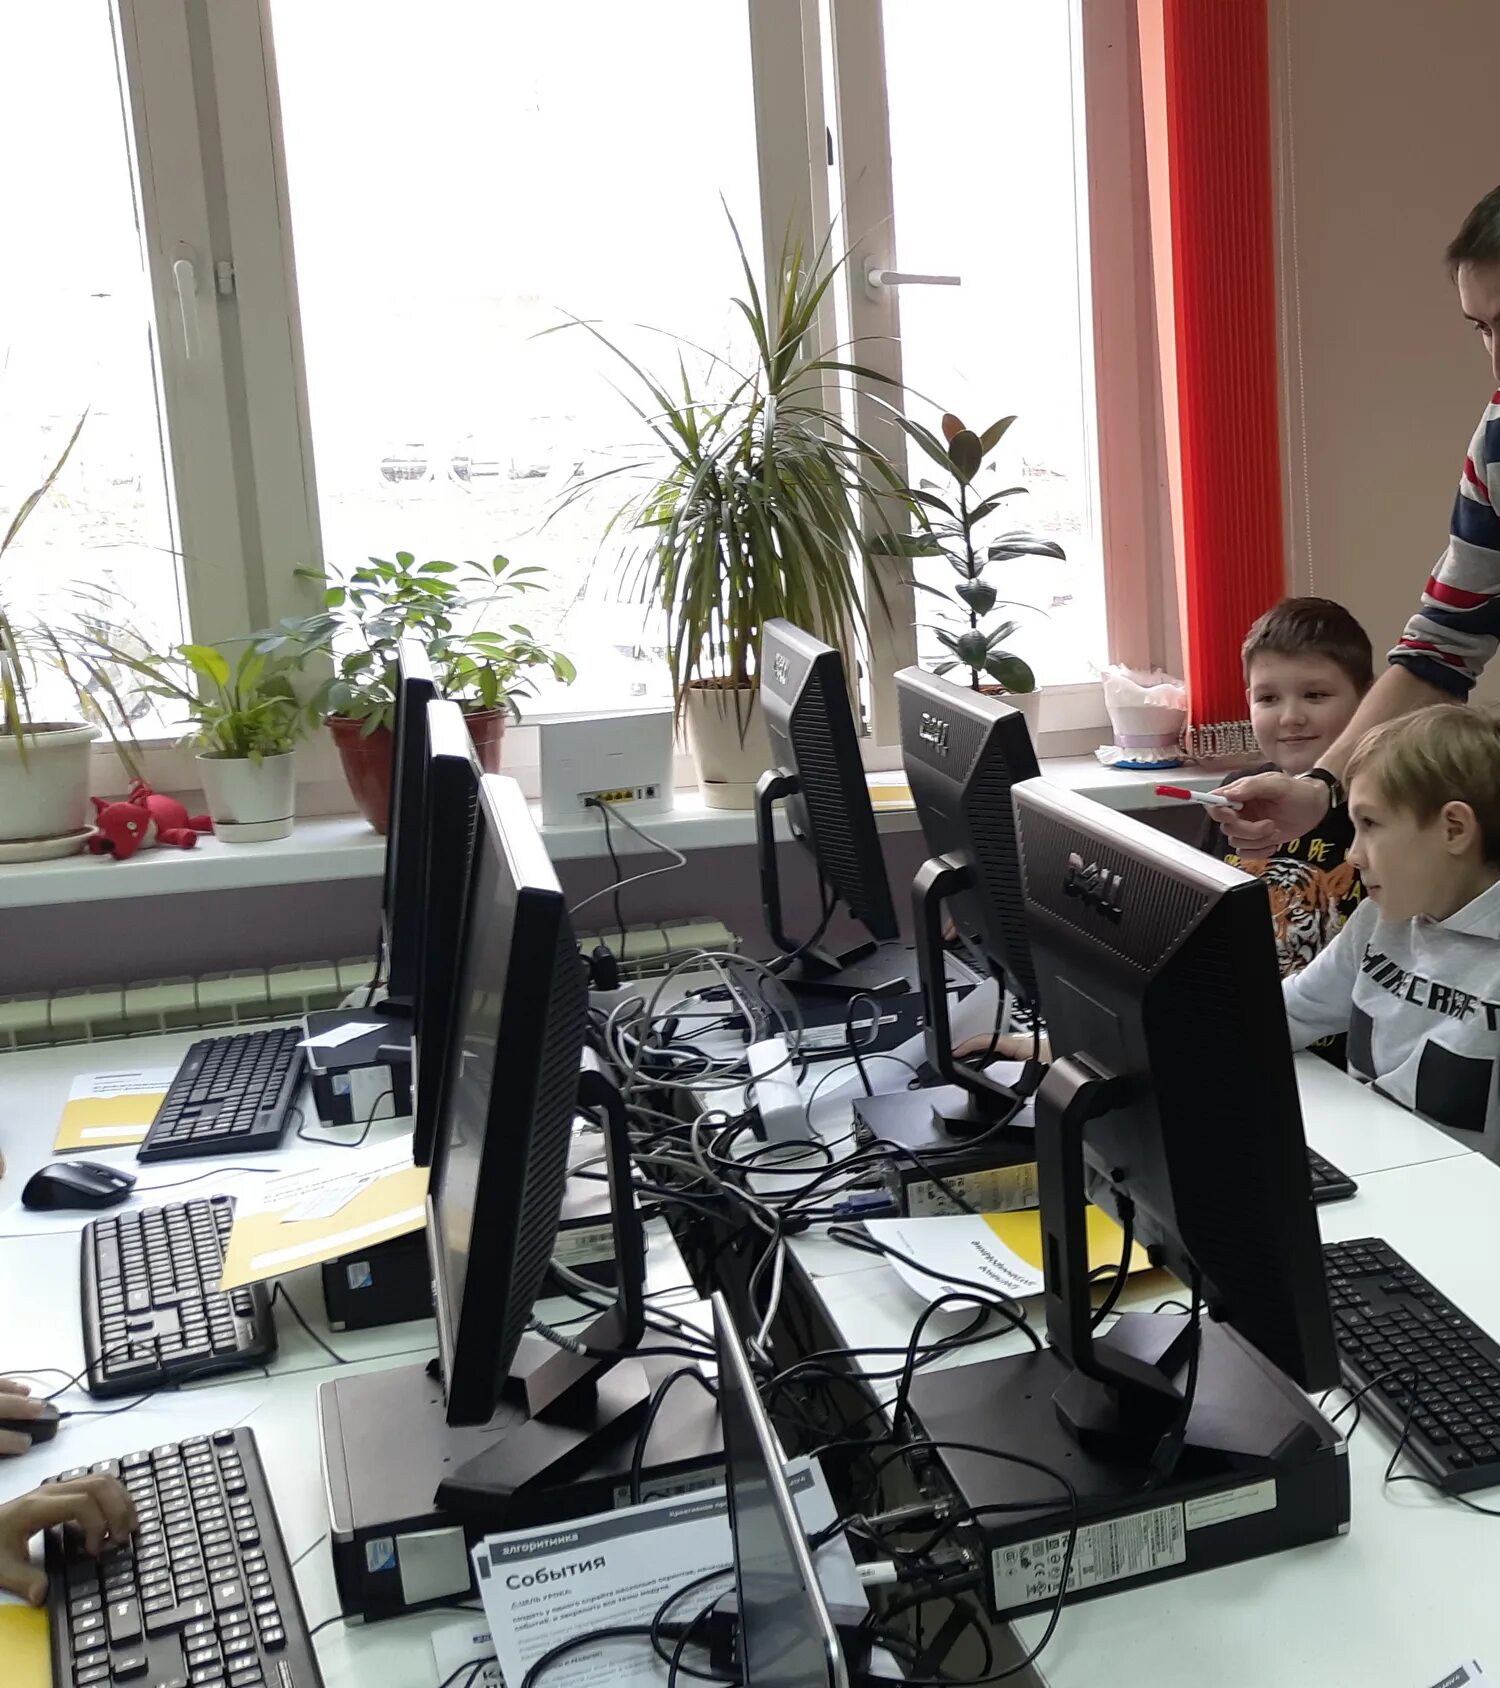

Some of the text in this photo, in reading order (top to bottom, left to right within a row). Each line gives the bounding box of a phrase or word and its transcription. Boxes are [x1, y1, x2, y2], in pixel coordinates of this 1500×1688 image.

[1307, 838, 1336, 862] BE
[1063, 851, 1123, 914] DELL
[502, 1532, 579, 1556] алгоритмика
[505, 1555, 606, 1590] События
